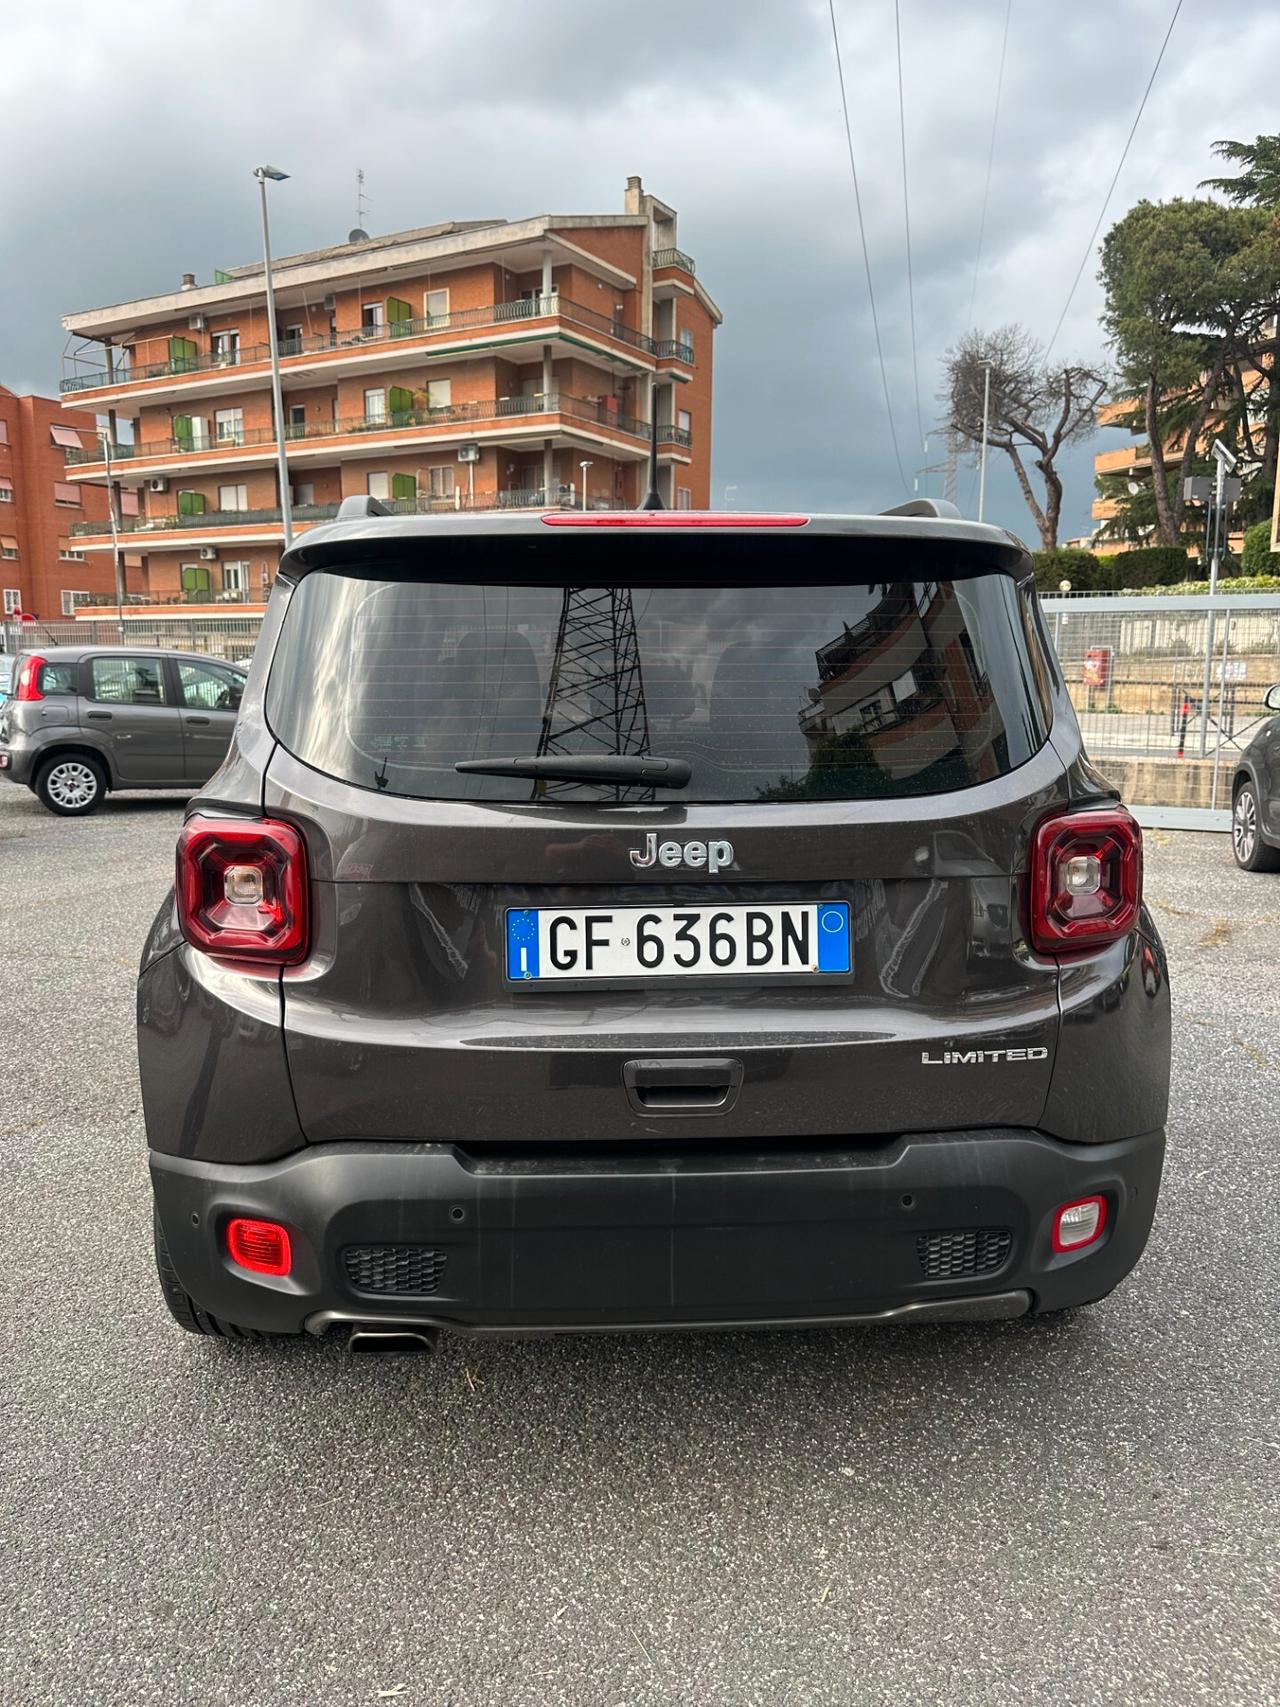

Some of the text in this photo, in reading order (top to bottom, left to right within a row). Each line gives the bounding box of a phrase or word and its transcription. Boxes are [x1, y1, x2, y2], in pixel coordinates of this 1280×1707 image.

[629, 832, 734, 874] Jeep
[549, 911, 809, 971] GF 636BN
[921, 1047, 1049, 1065] LIMITED
